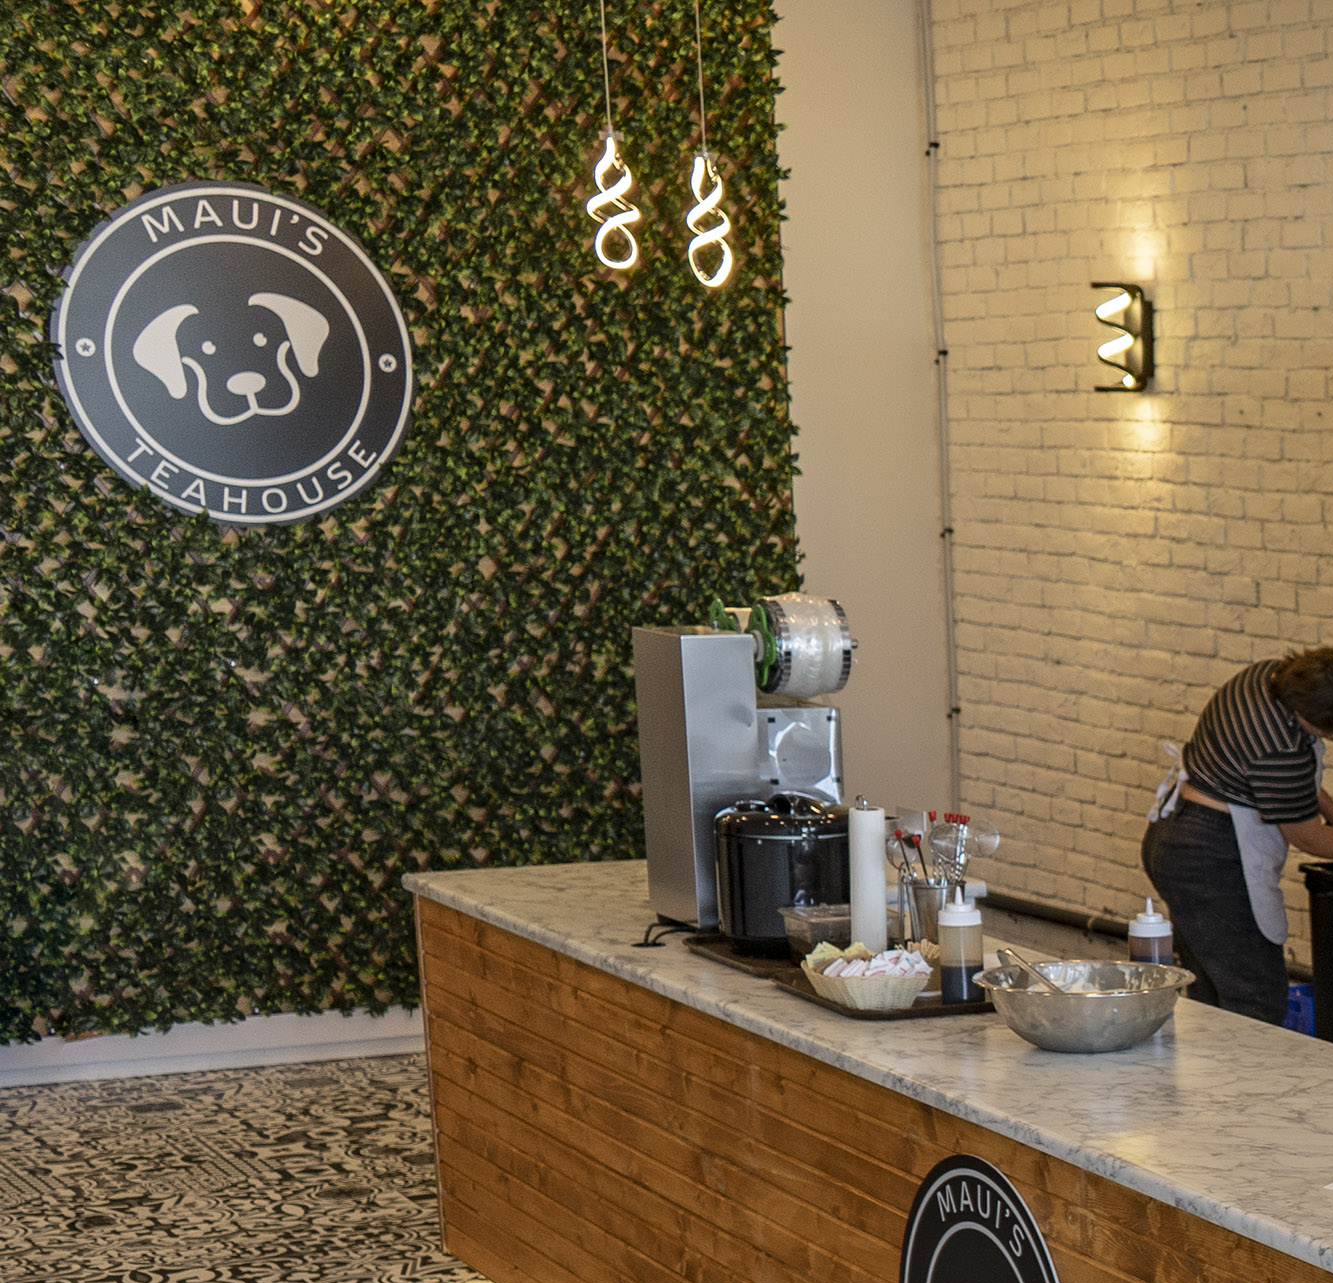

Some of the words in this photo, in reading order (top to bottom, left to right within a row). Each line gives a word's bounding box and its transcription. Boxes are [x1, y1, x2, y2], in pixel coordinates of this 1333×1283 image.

[140, 199, 329, 256] MAUI'S
[124, 438, 377, 514] TEAHOUSE
[936, 1181, 1026, 1258] MAUI'S
